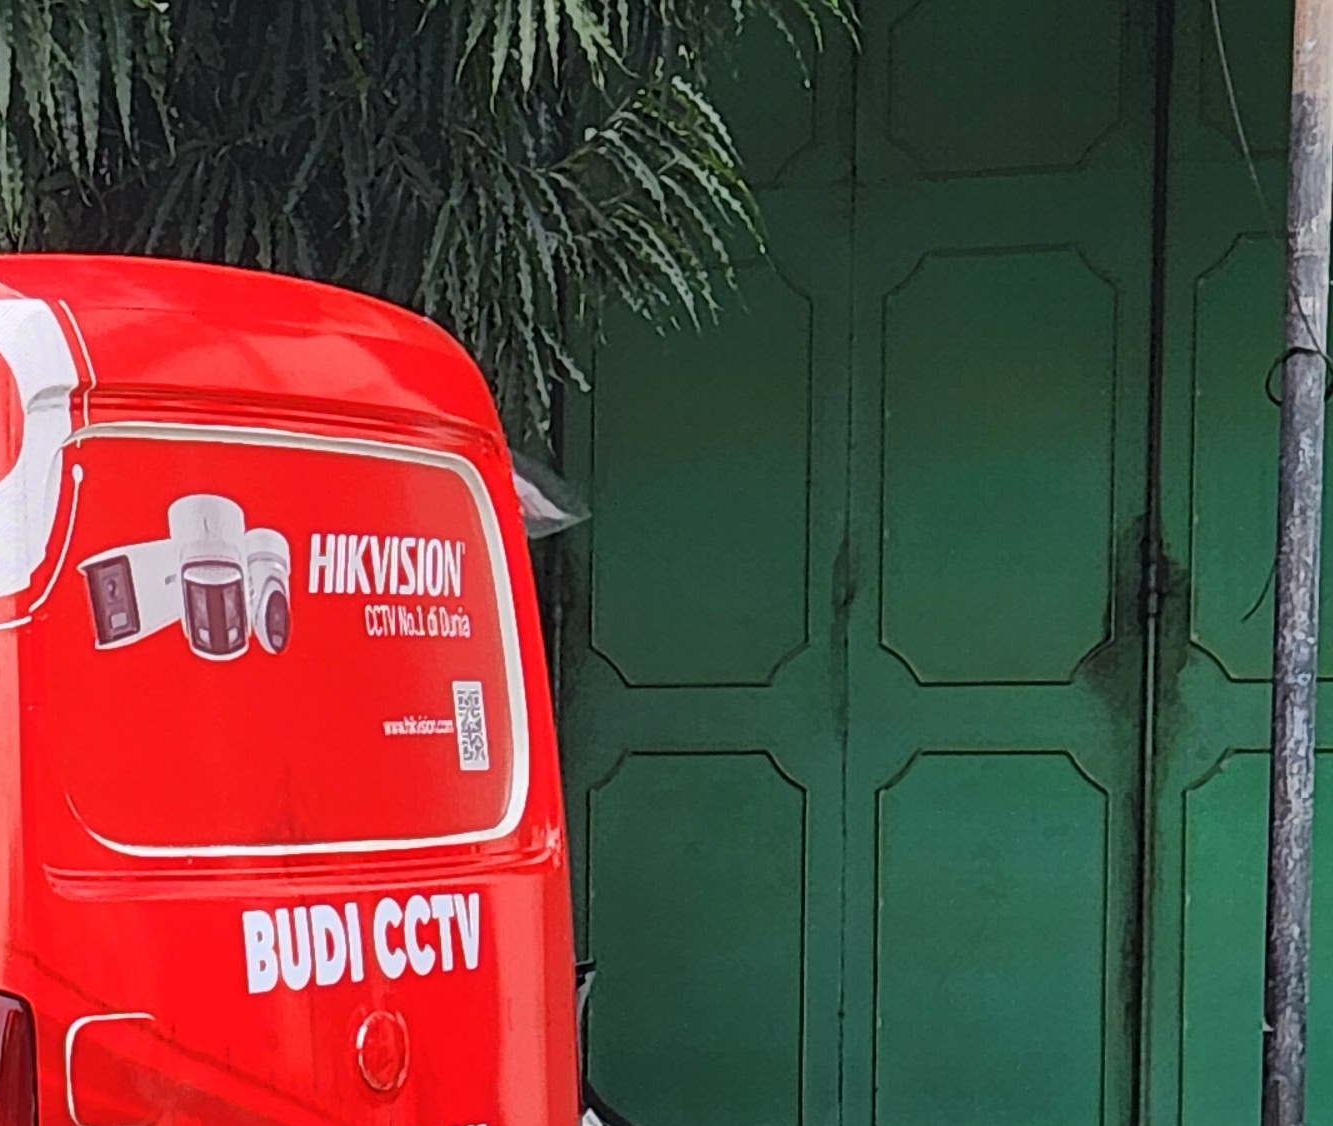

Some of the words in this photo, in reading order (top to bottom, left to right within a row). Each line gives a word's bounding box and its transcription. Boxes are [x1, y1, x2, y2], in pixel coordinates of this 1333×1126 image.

[308, 533, 462, 598] HIKVISION
[364, 604, 396, 637] CCTV
[438, 606, 471, 639] Dunia
[241, 900, 365, 995] BUDI
[372, 892, 481, 981] CCTV
